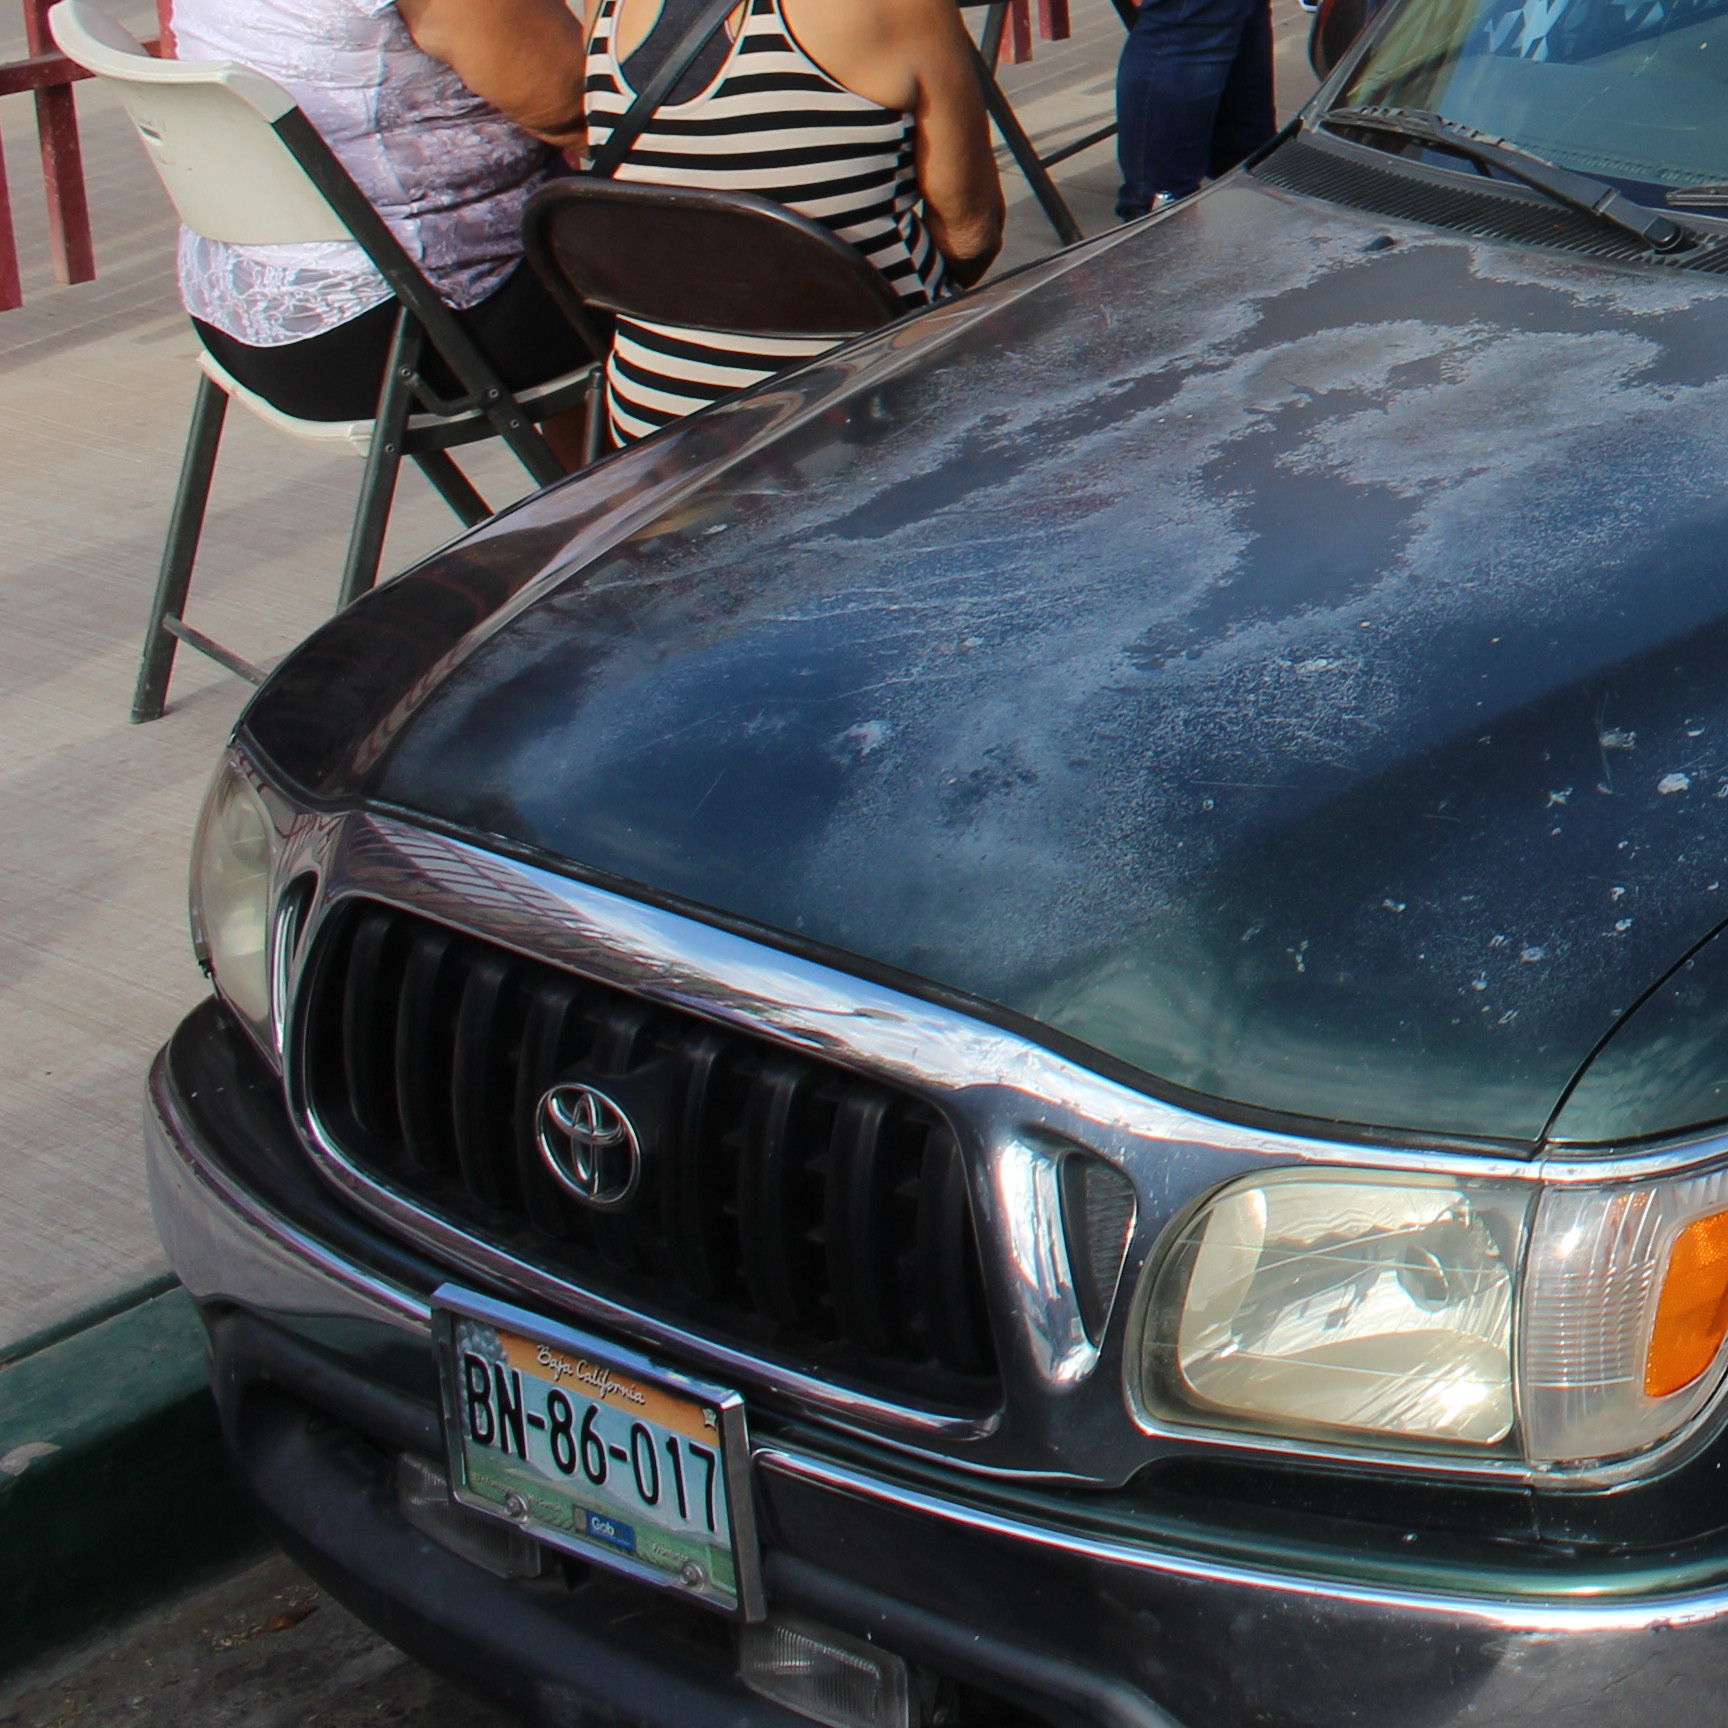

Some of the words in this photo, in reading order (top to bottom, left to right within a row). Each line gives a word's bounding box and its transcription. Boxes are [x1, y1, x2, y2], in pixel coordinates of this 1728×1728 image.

[537, 1344, 573, 1382] Baja
[575, 1359, 646, 1404] California
[464, 1351, 717, 1533] BN-86-017
